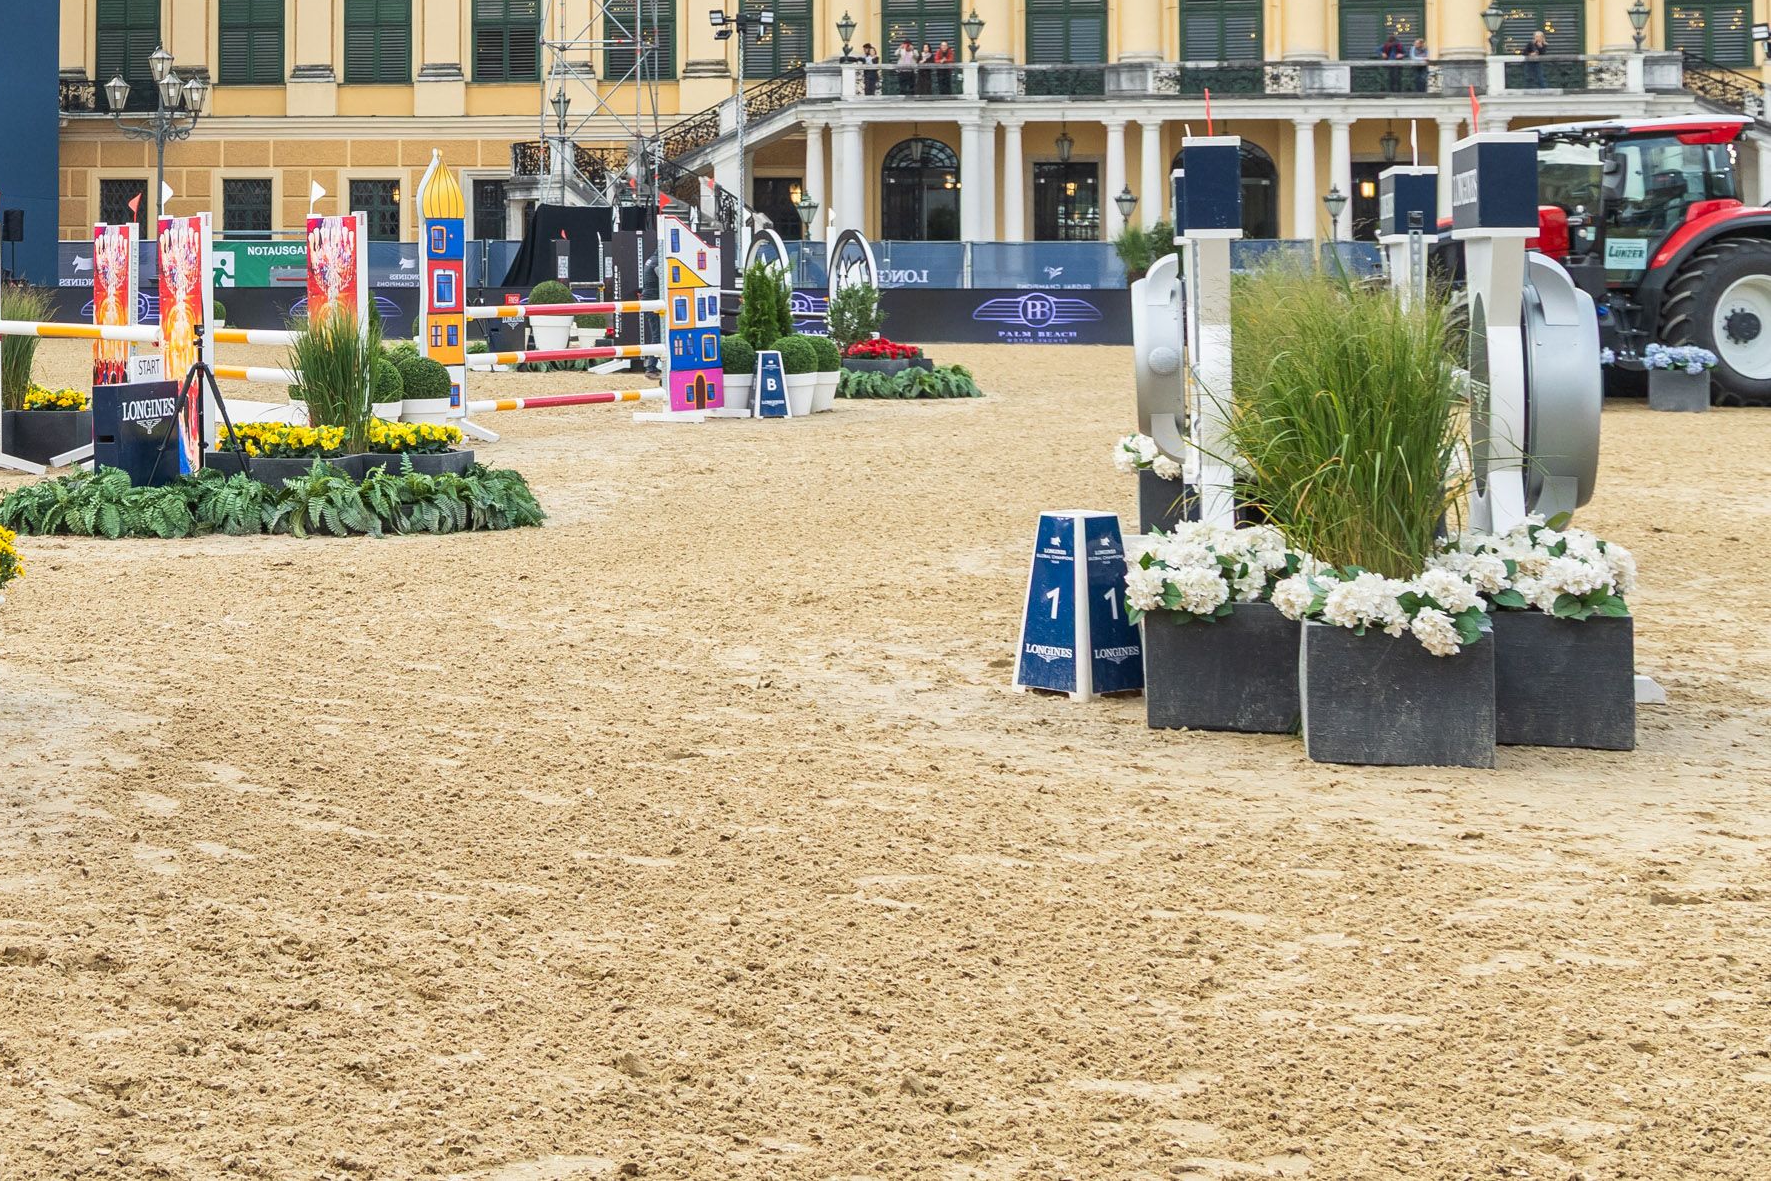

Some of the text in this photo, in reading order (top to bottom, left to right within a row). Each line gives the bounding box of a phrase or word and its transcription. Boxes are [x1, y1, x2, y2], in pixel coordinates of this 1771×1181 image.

[1608, 246, 1645, 259] LUNZER
[138, 359, 160, 375] START
[767, 378, 777, 391] B
[121, 397, 175, 421] LONGINES
[1046, 587, 1060, 620] 1
[1103, 587, 1119, 620] 1
[1026, 643, 1073, 659] LONGINES
[1094, 646, 1140, 659] LONGINES
